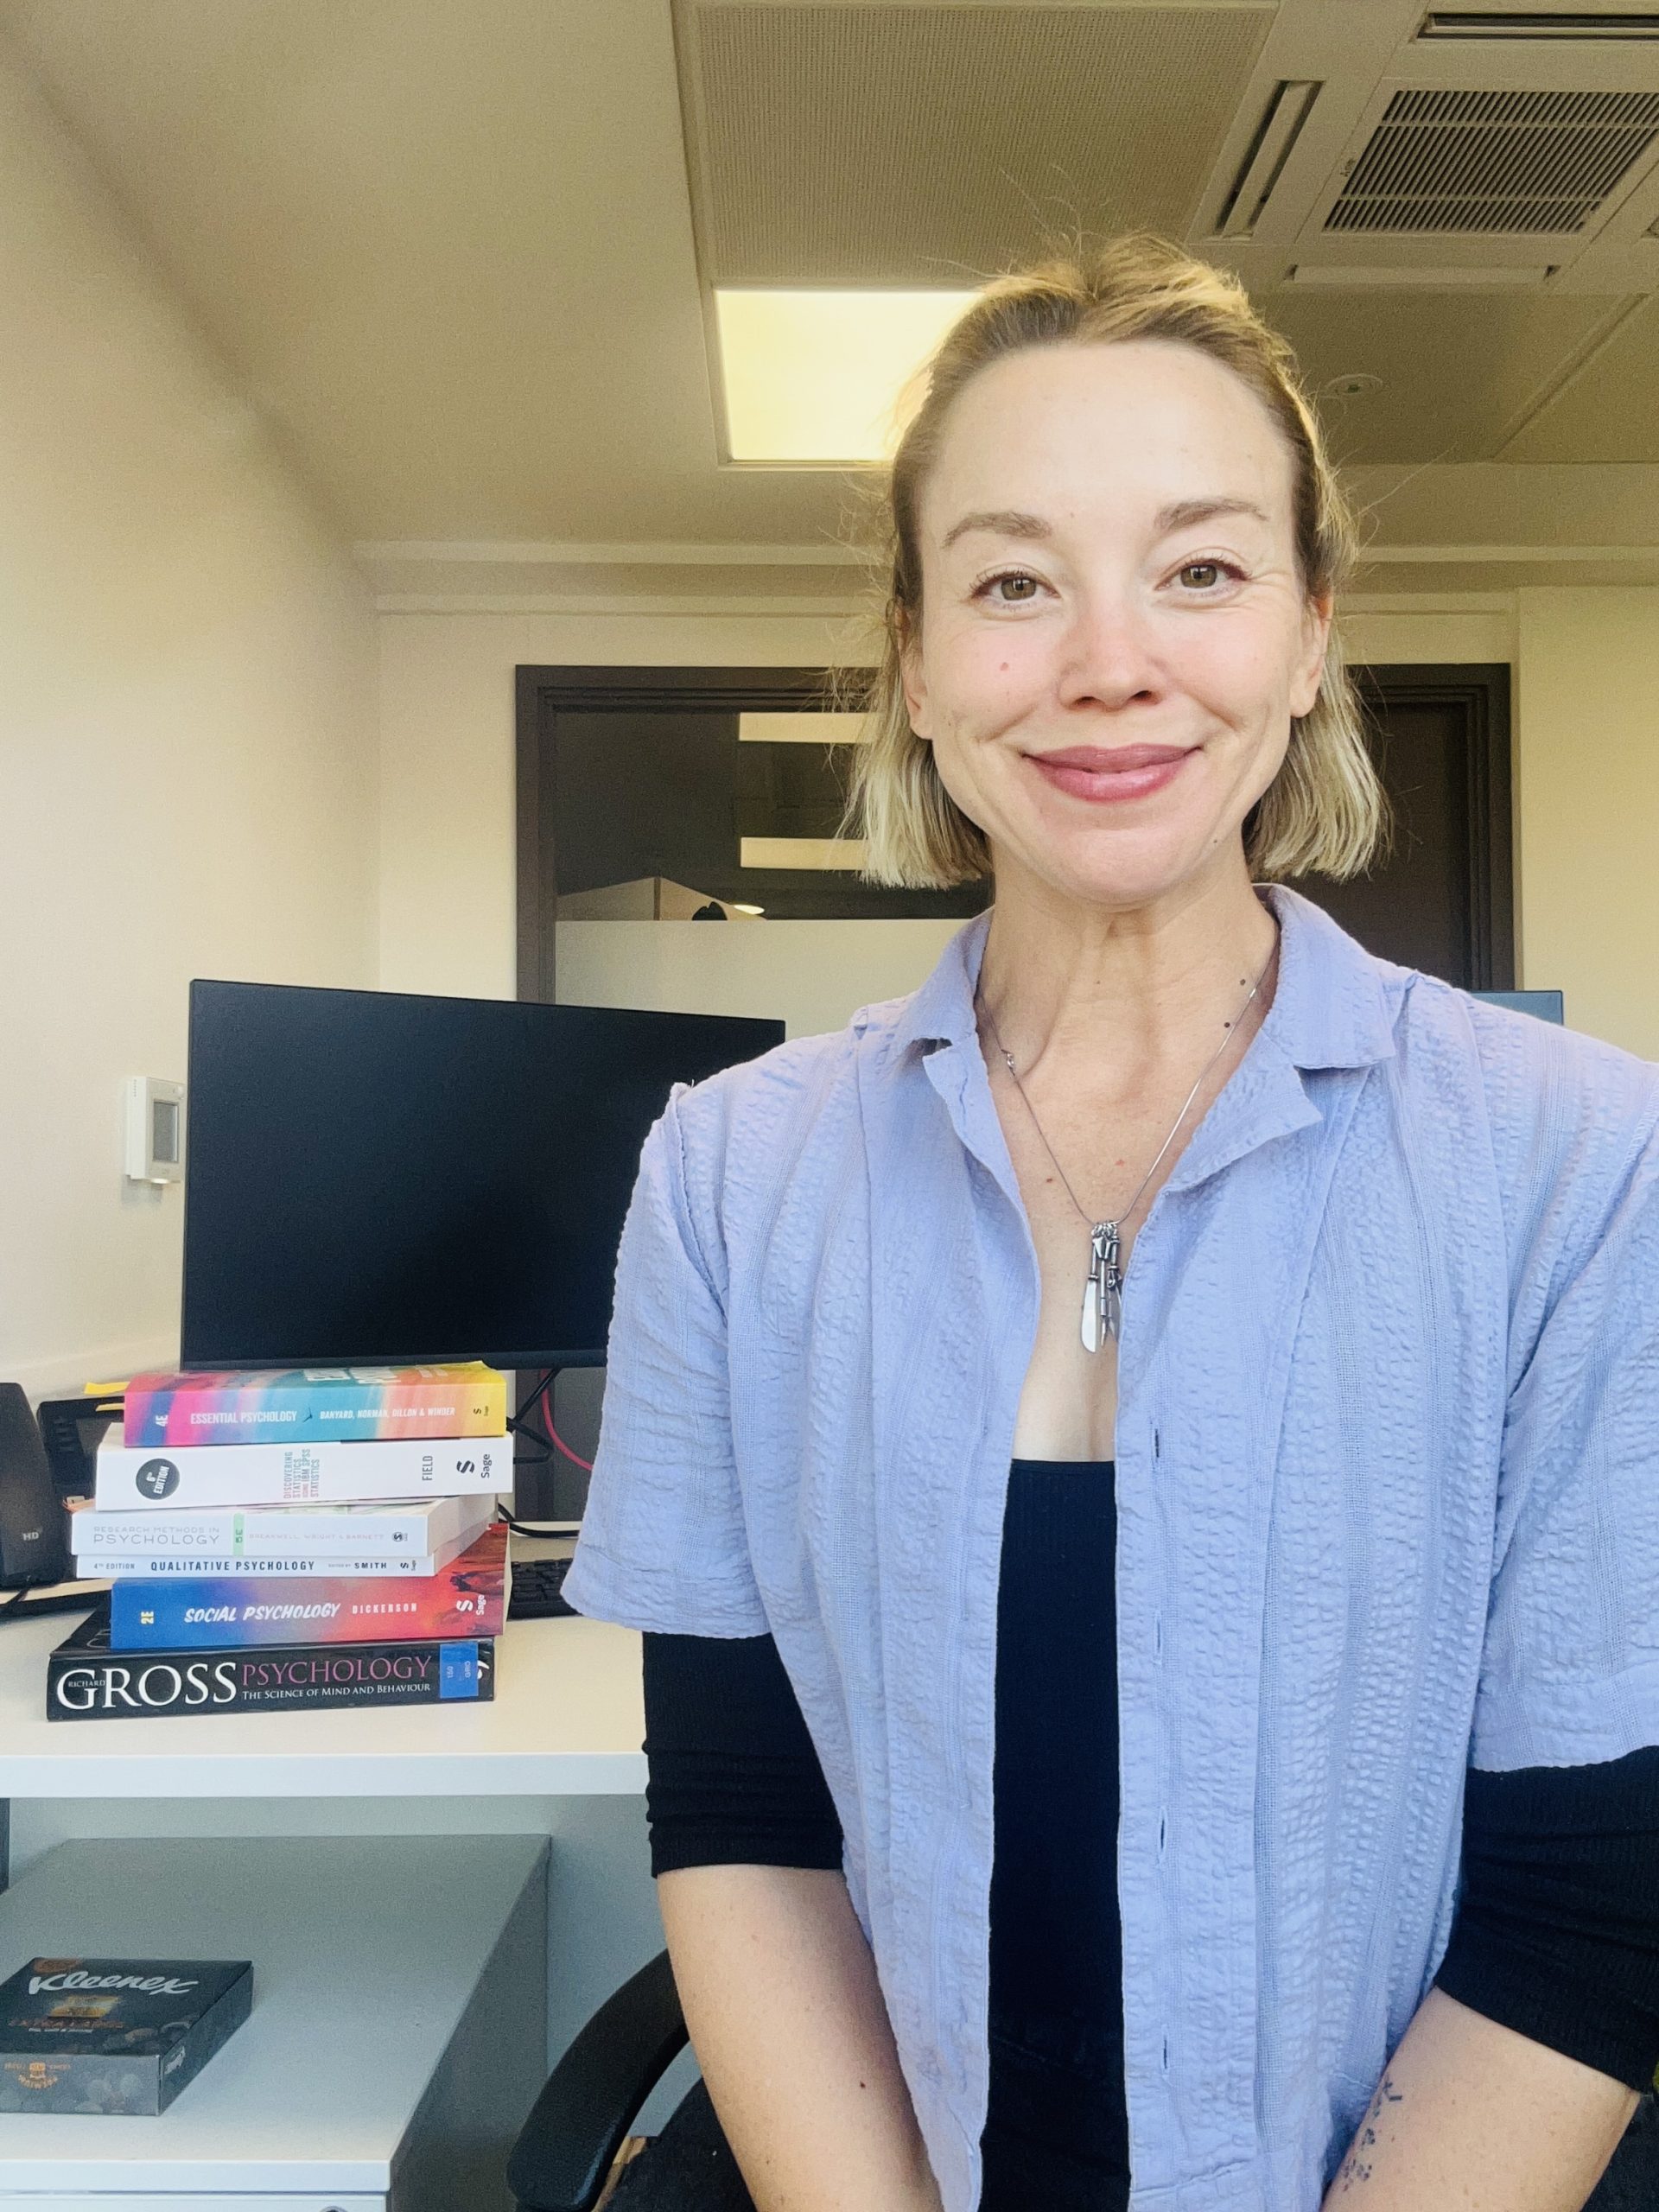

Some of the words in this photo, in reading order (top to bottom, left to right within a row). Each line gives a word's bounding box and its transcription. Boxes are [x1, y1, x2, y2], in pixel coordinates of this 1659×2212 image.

[156, 1414, 168, 1427] 4E
[190, 1413, 238, 1425] ESSENTIAL
[241, 1411, 297, 1424] PSYCHOLOGY
[320, 1410, 353, 1420] BANYARD,
[358, 1409, 389, 1419] NORMAN,
[391, 1408, 417, 1418] DILLON
[419, 1408, 424, 1417] &
[428, 1407, 455, 1416] WINDER
[302, 1449, 310, 1466] SPSS
[480, 1453, 492, 1478] Sage
[283, 1452, 293, 1499] DISCOVERING
[301, 1469, 310, 1482] IBM
[422, 1455, 433, 1481] FIELD
[153, 1465, 169, 1494] EDITION
[293, 1459, 302, 1498] STATISTICS
[310, 1459, 320, 1497] STATISTICS
[22, 1532, 39, 1541] HD
[93, 1534, 219, 1545] PSYCHOLOGY
[150, 1561, 230, 1572] QUALITATIVE
[236, 1560, 315, 1571] PSYCHOLOGY
[184, 1605, 237, 1623] SOCIAL
[243, 1603, 341, 1621] PSYCHOLOGY
[352, 1603, 417, 1614] DICKERSON
[476, 1594, 486, 1615] Sage
[141, 1611, 154, 1624] 2E
[243, 1656, 431, 1686] PSYCHOLOGY
[57, 1662, 237, 1710] GROSS
[264, 1689, 303, 1699] SCIENCE
[307, 1688, 319, 1697] OF
[321, 1687, 348, 1696] MIND
[350, 1686, 374, 1694] AND
[377, 1683, 431, 1694] BEHAVIOUR
[29, 1971, 199, 1995] Kleenex
